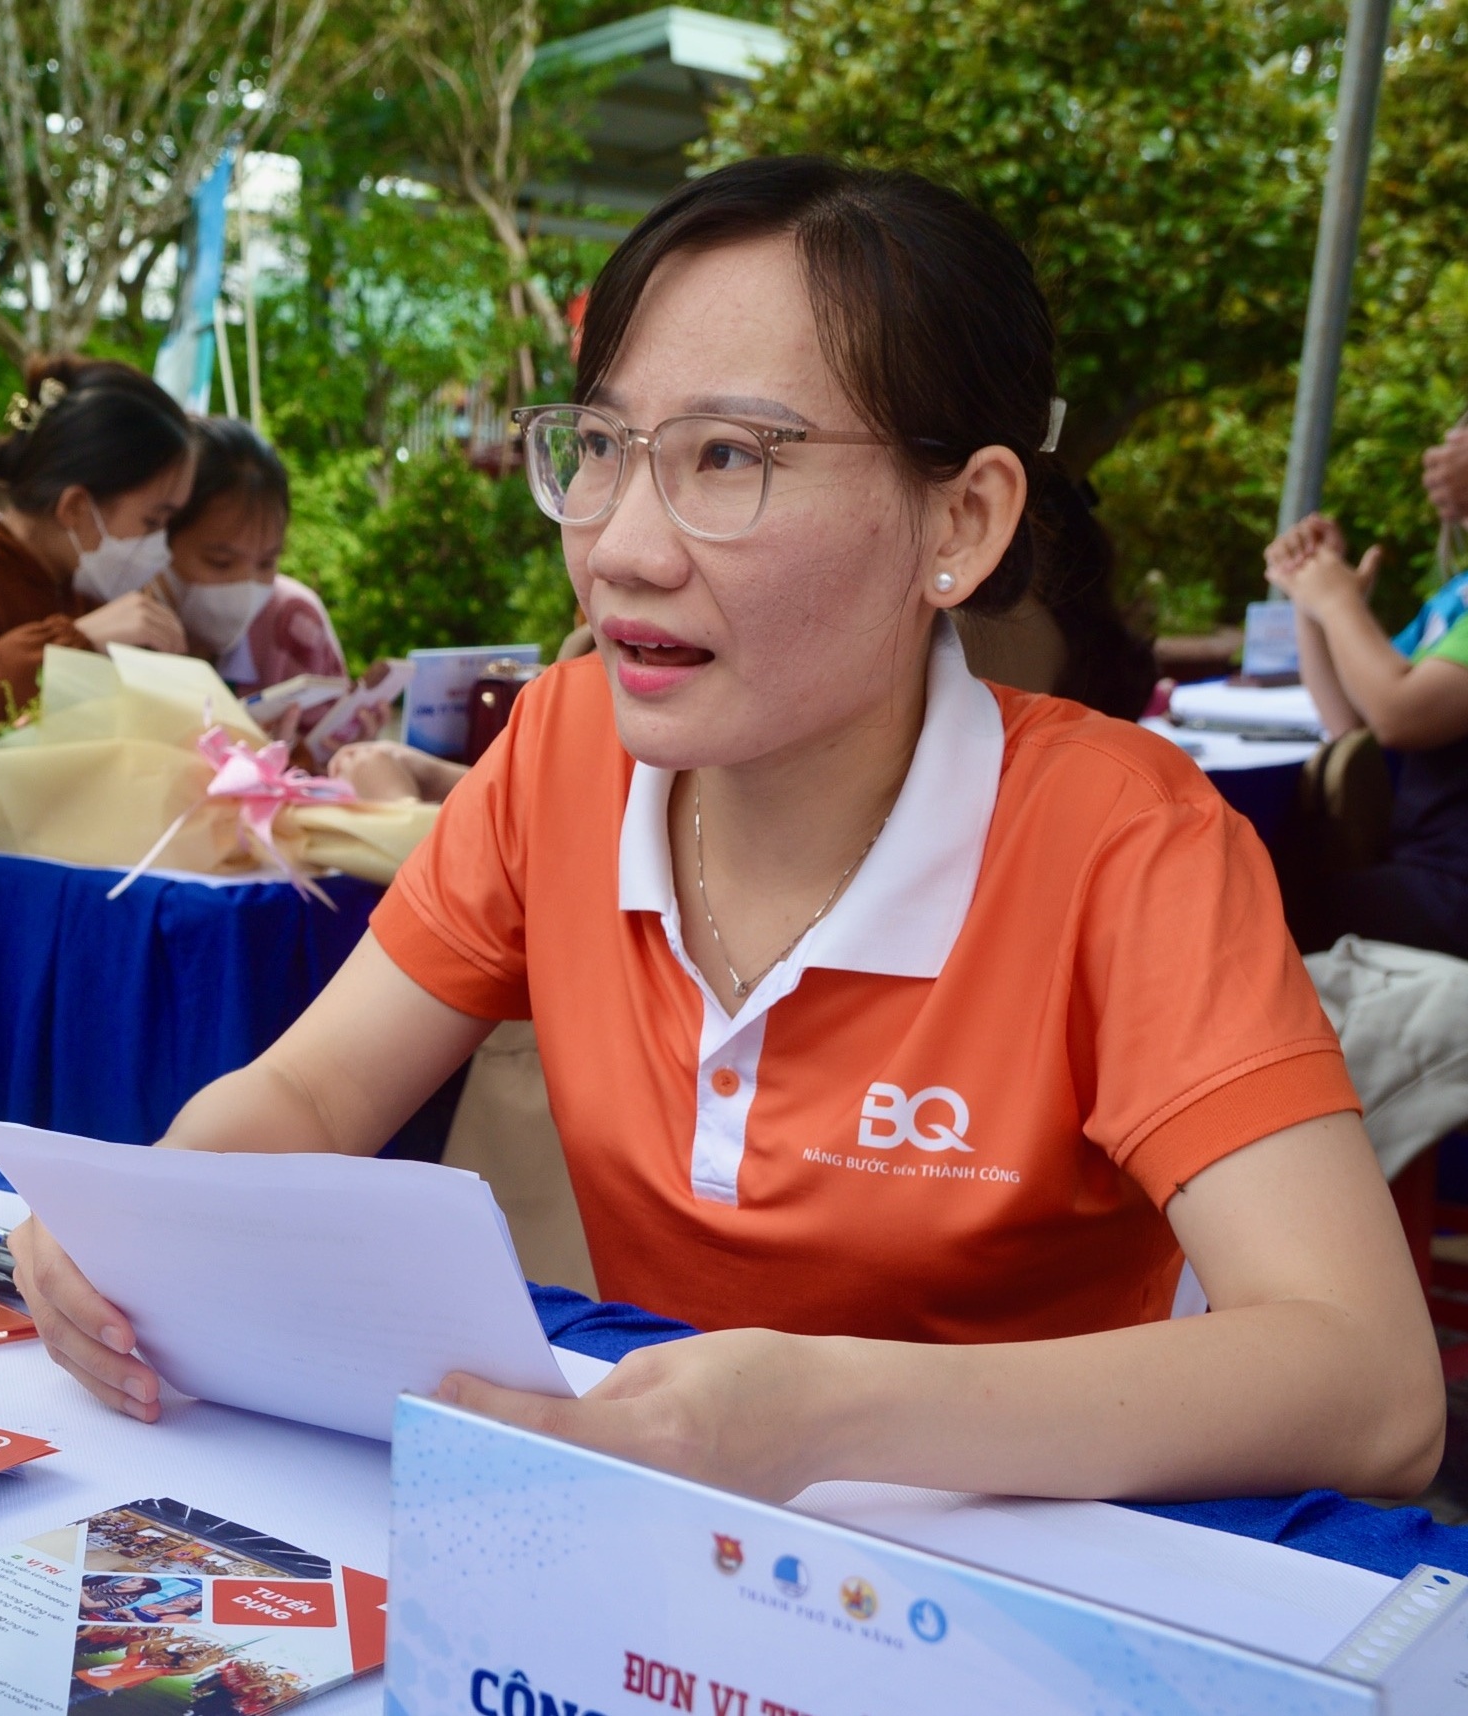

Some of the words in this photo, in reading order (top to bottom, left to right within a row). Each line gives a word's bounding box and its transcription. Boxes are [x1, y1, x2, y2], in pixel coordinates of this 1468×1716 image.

[857, 1081, 976, 1153] BQ
[802, 1147, 842, 1167] NÂNG
[845, 1156, 890, 1175] BƯỚC
[893, 1164, 917, 1177] ĐẾN
[921, 1162, 975, 1180] THÀNH
[979, 1167, 1021, 1184] CÔNG
[26, 1558, 43, 1570] VỊ
[39, 1563, 66, 1575] TRÍ
[231, 1595, 292, 1620] DỤNG
[252, 1586, 317, 1614] TUYỂN
[623, 1650, 696, 1713] ĐƠN
